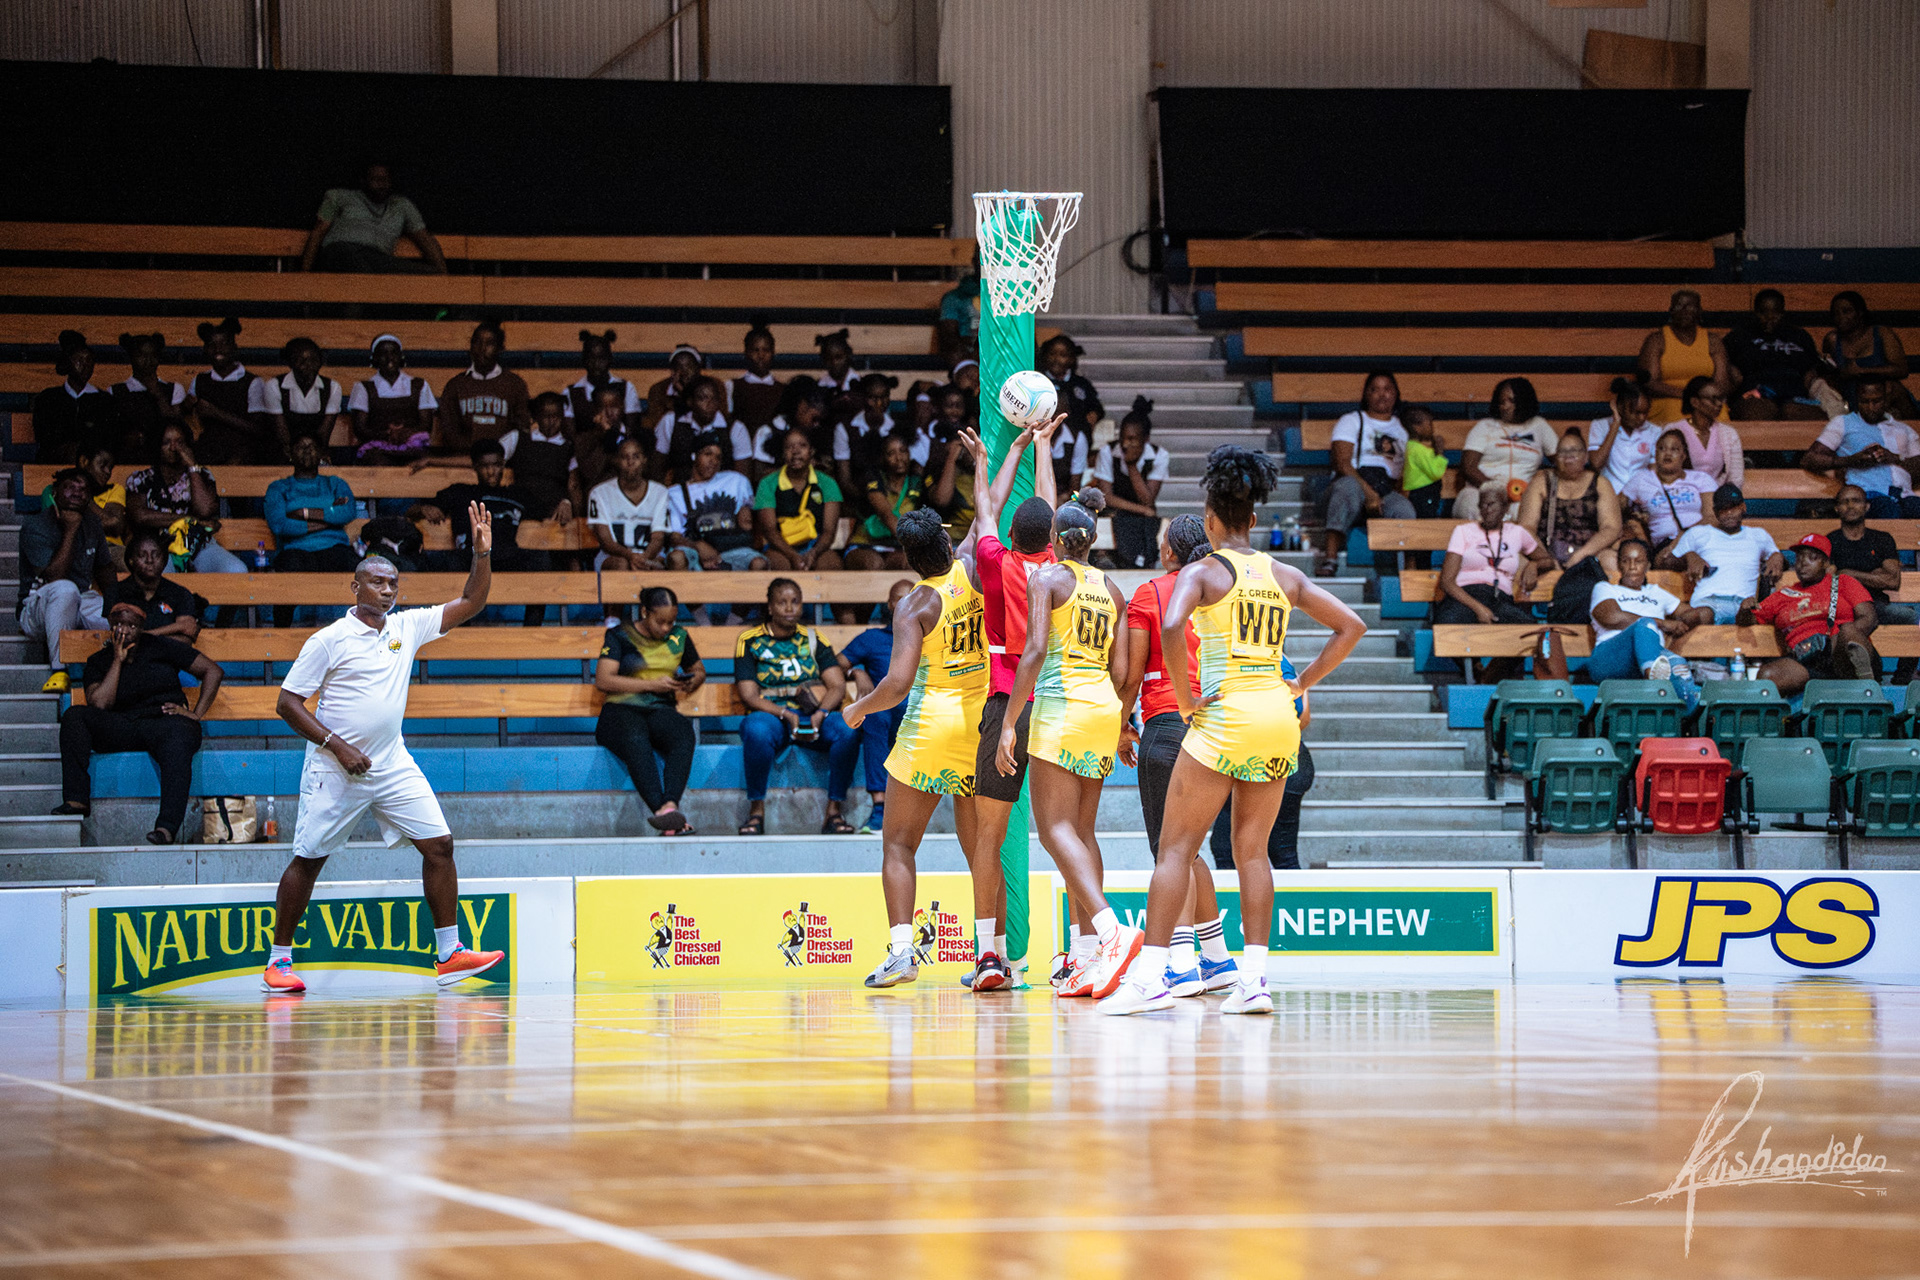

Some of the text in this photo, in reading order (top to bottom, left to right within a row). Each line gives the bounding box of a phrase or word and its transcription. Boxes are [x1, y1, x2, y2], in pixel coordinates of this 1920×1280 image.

[1077, 593, 1110, 605] K. SHAW
[1238, 589, 1280, 600] Z. GREEN
[951, 597, 981, 621] WILLIAMS
[1077, 606, 1110, 651] GD
[1237, 599, 1286, 648] WD
[950, 613, 984, 654] GK
[780, 657, 801, 677] 21
[674, 916, 695, 927] The
[806, 914, 828, 926] The
[937, 912, 958, 924] The
[1278, 908, 1430, 936] NEPHEW
[1613, 876, 1880, 969] JPS
[317, 898, 496, 956] VALLY
[806, 927, 832, 938] Best
[938, 926, 963, 937] Best
[674, 928, 700, 940] Best
[674, 940, 721, 953] Dressed
[807, 938, 853, 951] Dressed
[938, 938, 974, 949] Dresse
[674, 953, 720, 965] Chicken
[806, 952, 852, 964] Chicken
[938, 950, 975, 962] Chicke
